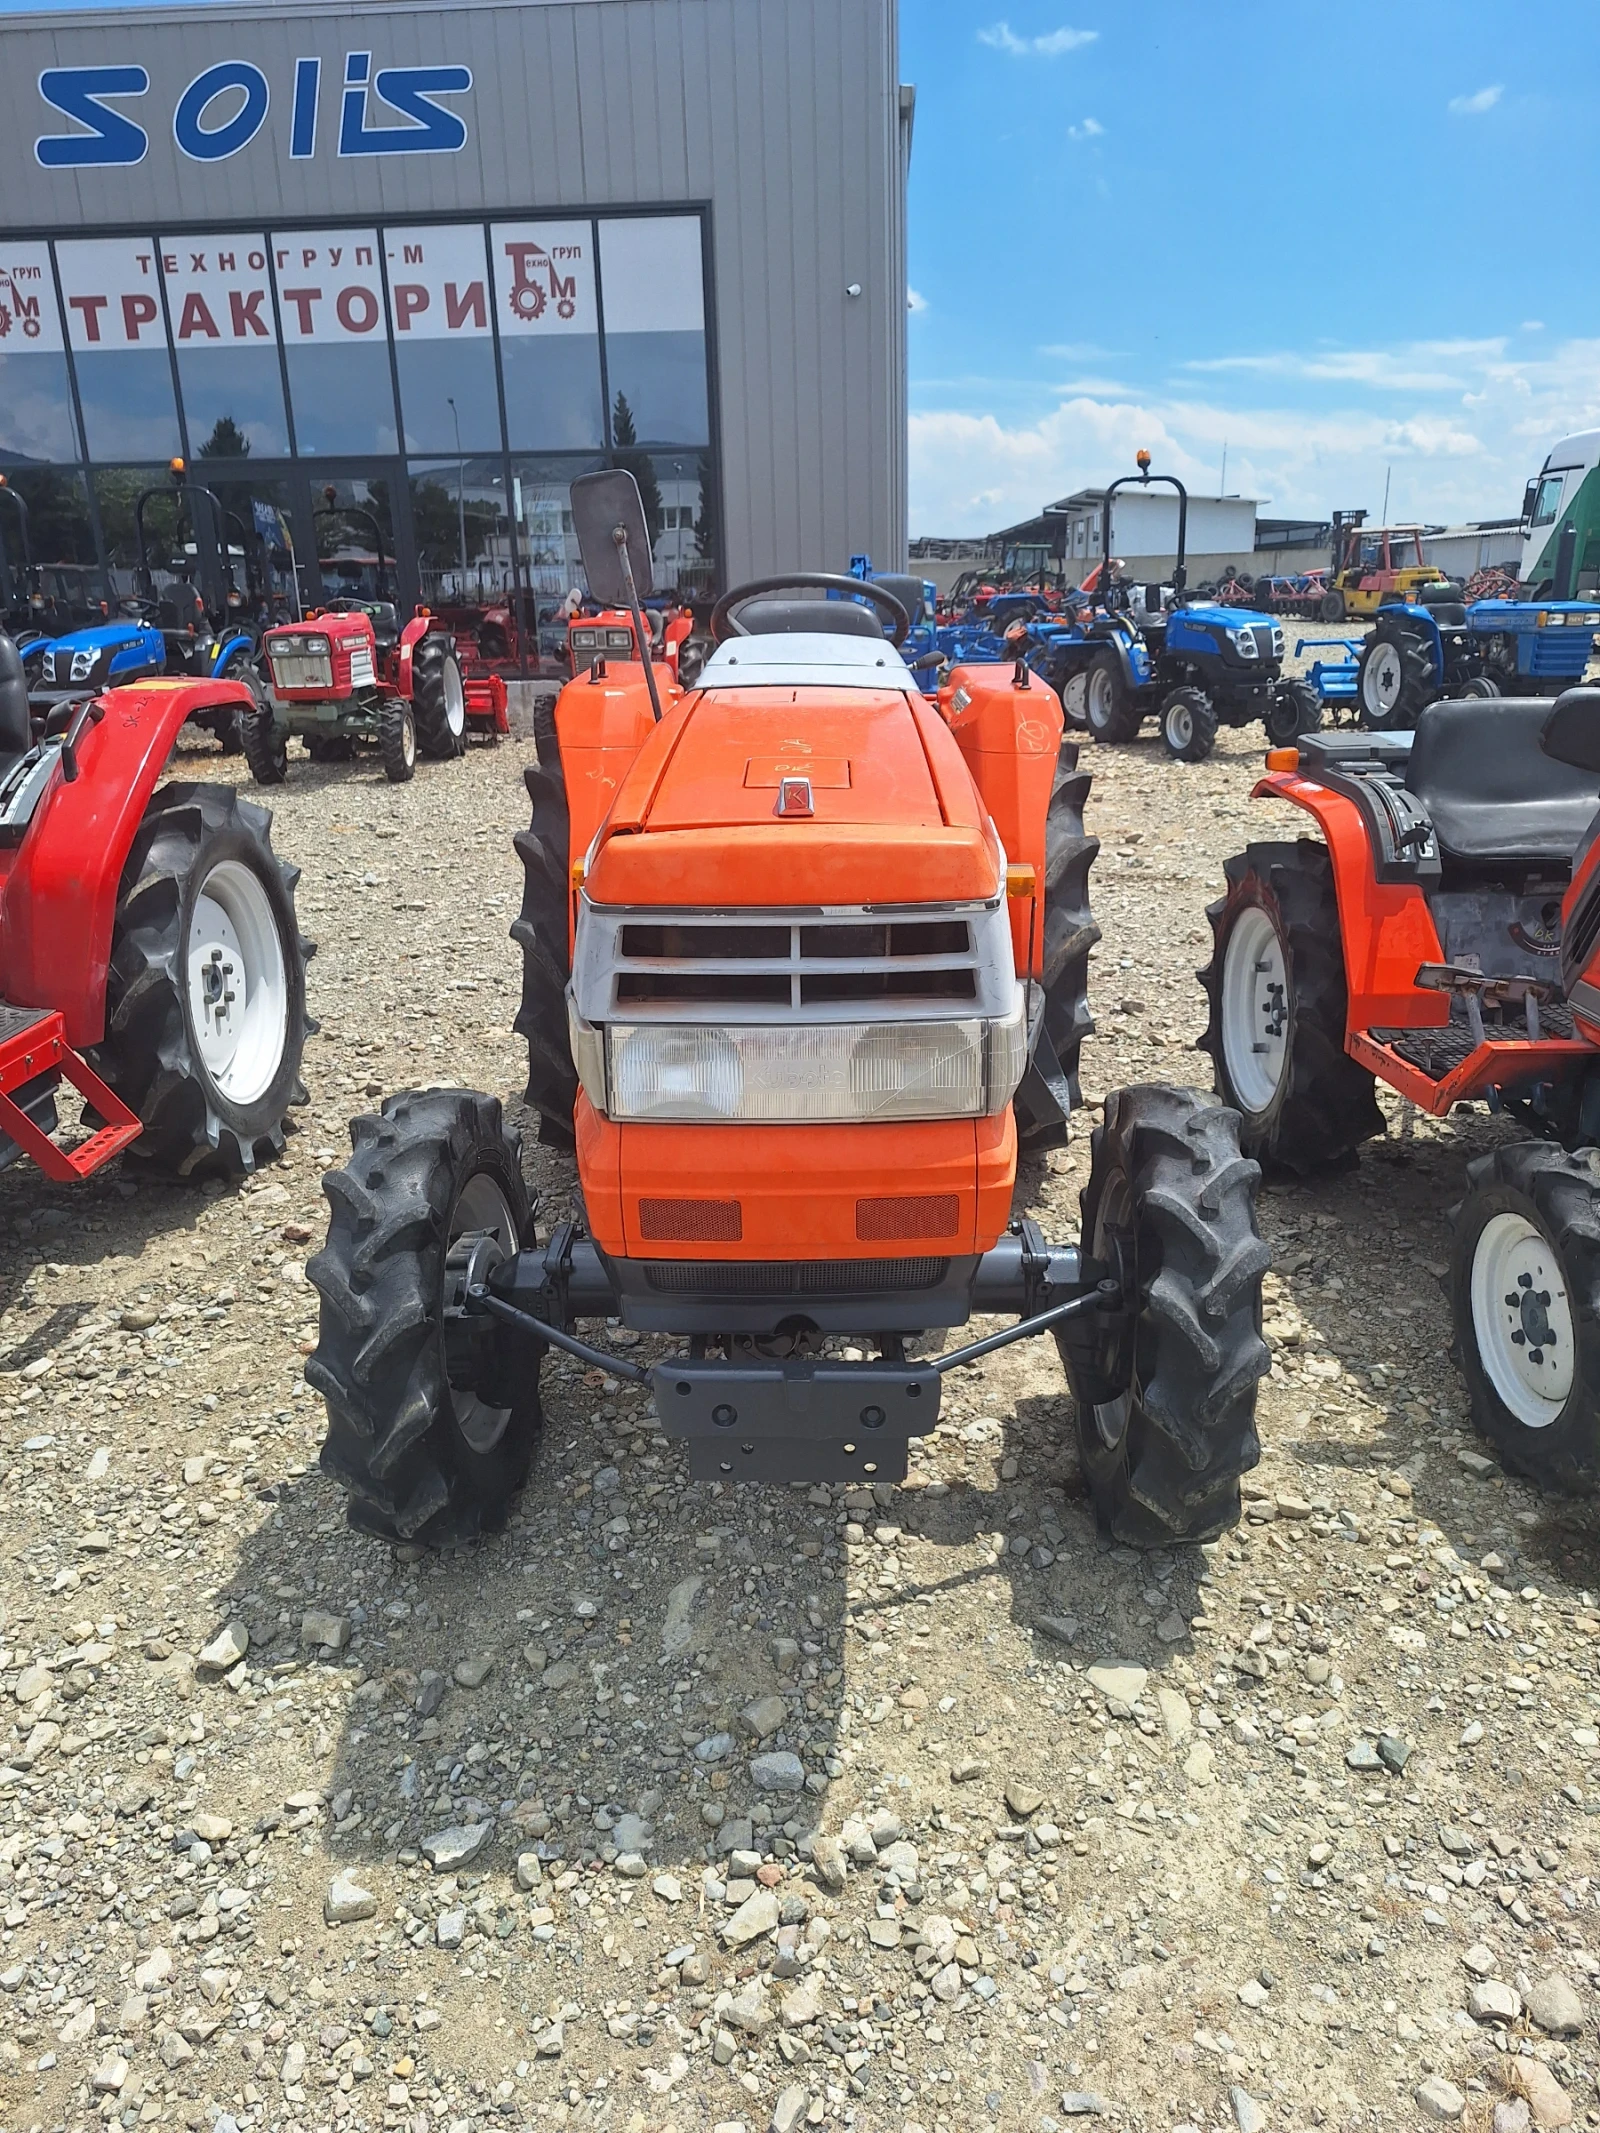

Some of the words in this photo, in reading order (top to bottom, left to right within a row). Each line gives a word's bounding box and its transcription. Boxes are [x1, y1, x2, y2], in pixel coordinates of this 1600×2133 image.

[552, 246, 581, 259] ГРУП
[12, 266, 41, 279] ГРУП
[69, 281, 488, 342] ТРАКТОРИ
[750, 1064, 847, 1090] Kubota
